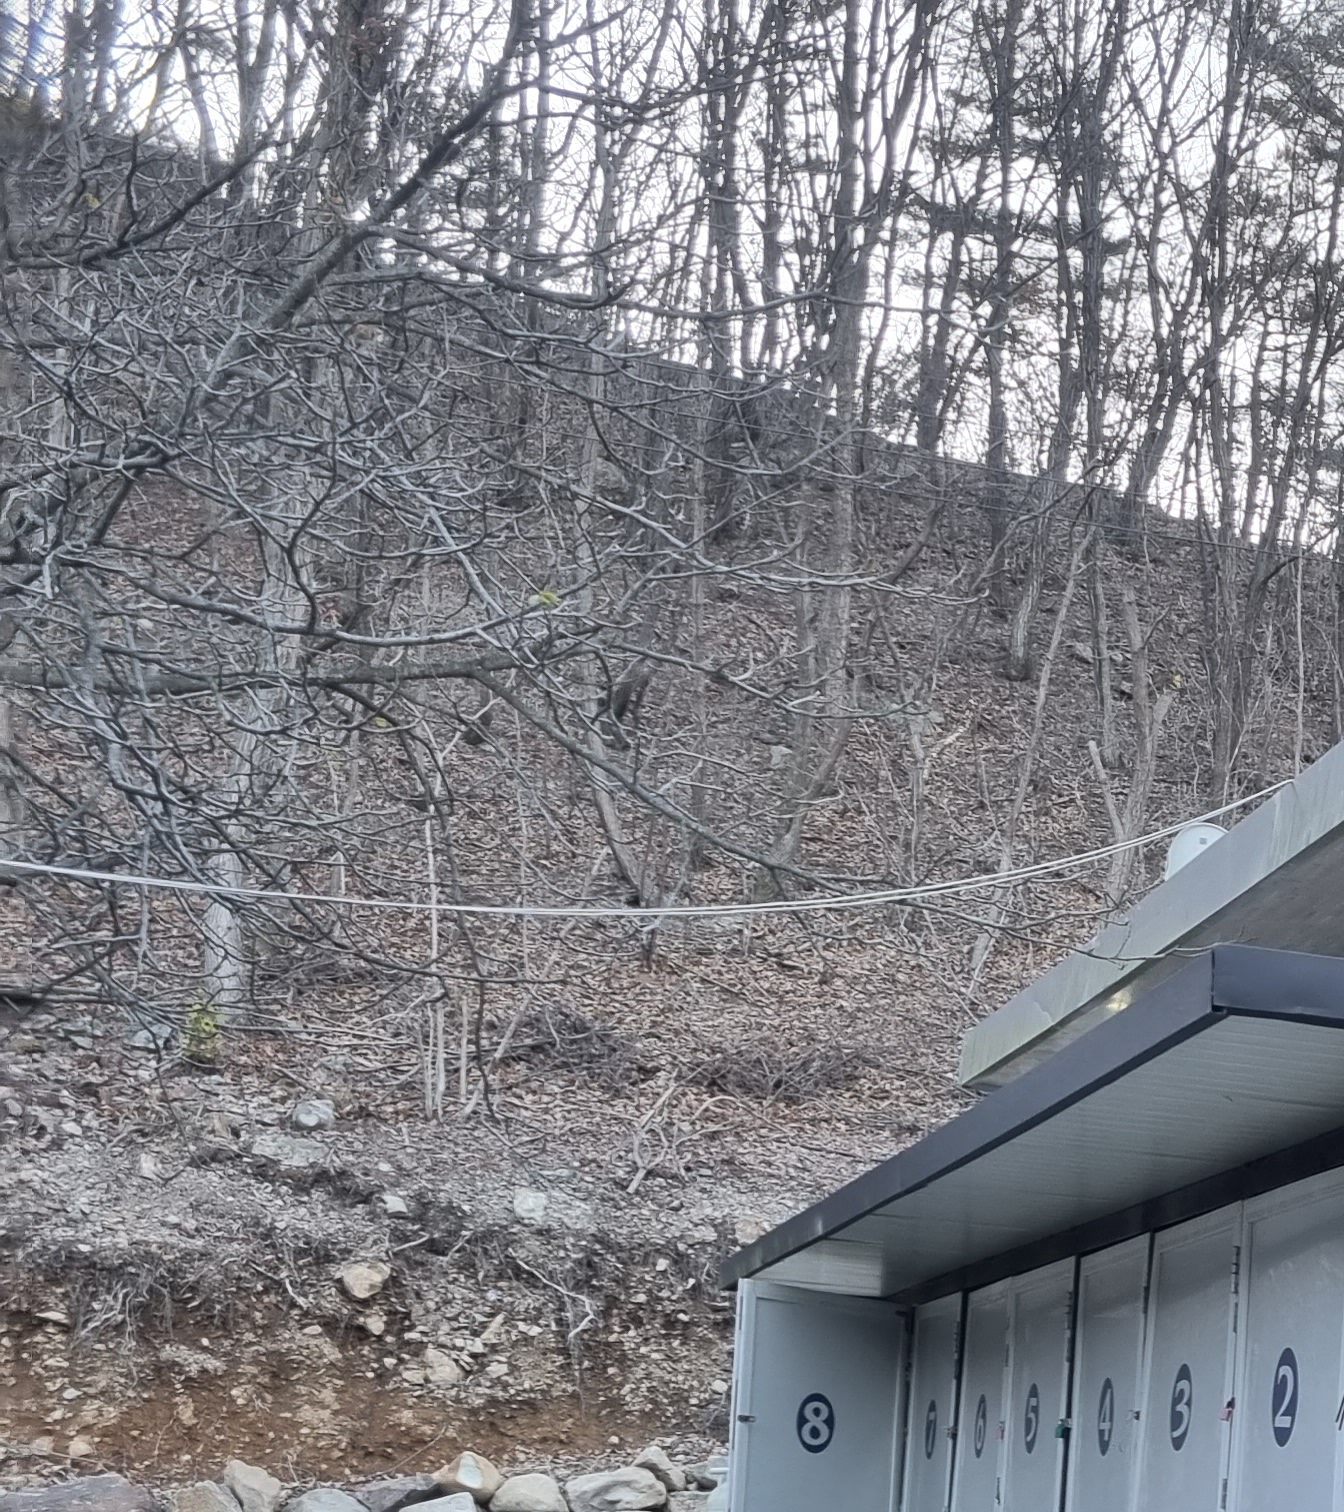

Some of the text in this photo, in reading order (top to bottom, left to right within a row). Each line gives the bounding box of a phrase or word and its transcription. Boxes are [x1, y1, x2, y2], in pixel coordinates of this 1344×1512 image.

[801, 1401, 830, 1446] 8
[1172, 1379, 1191, 1438] 3
[1274, 1365, 1294, 1428] 2
